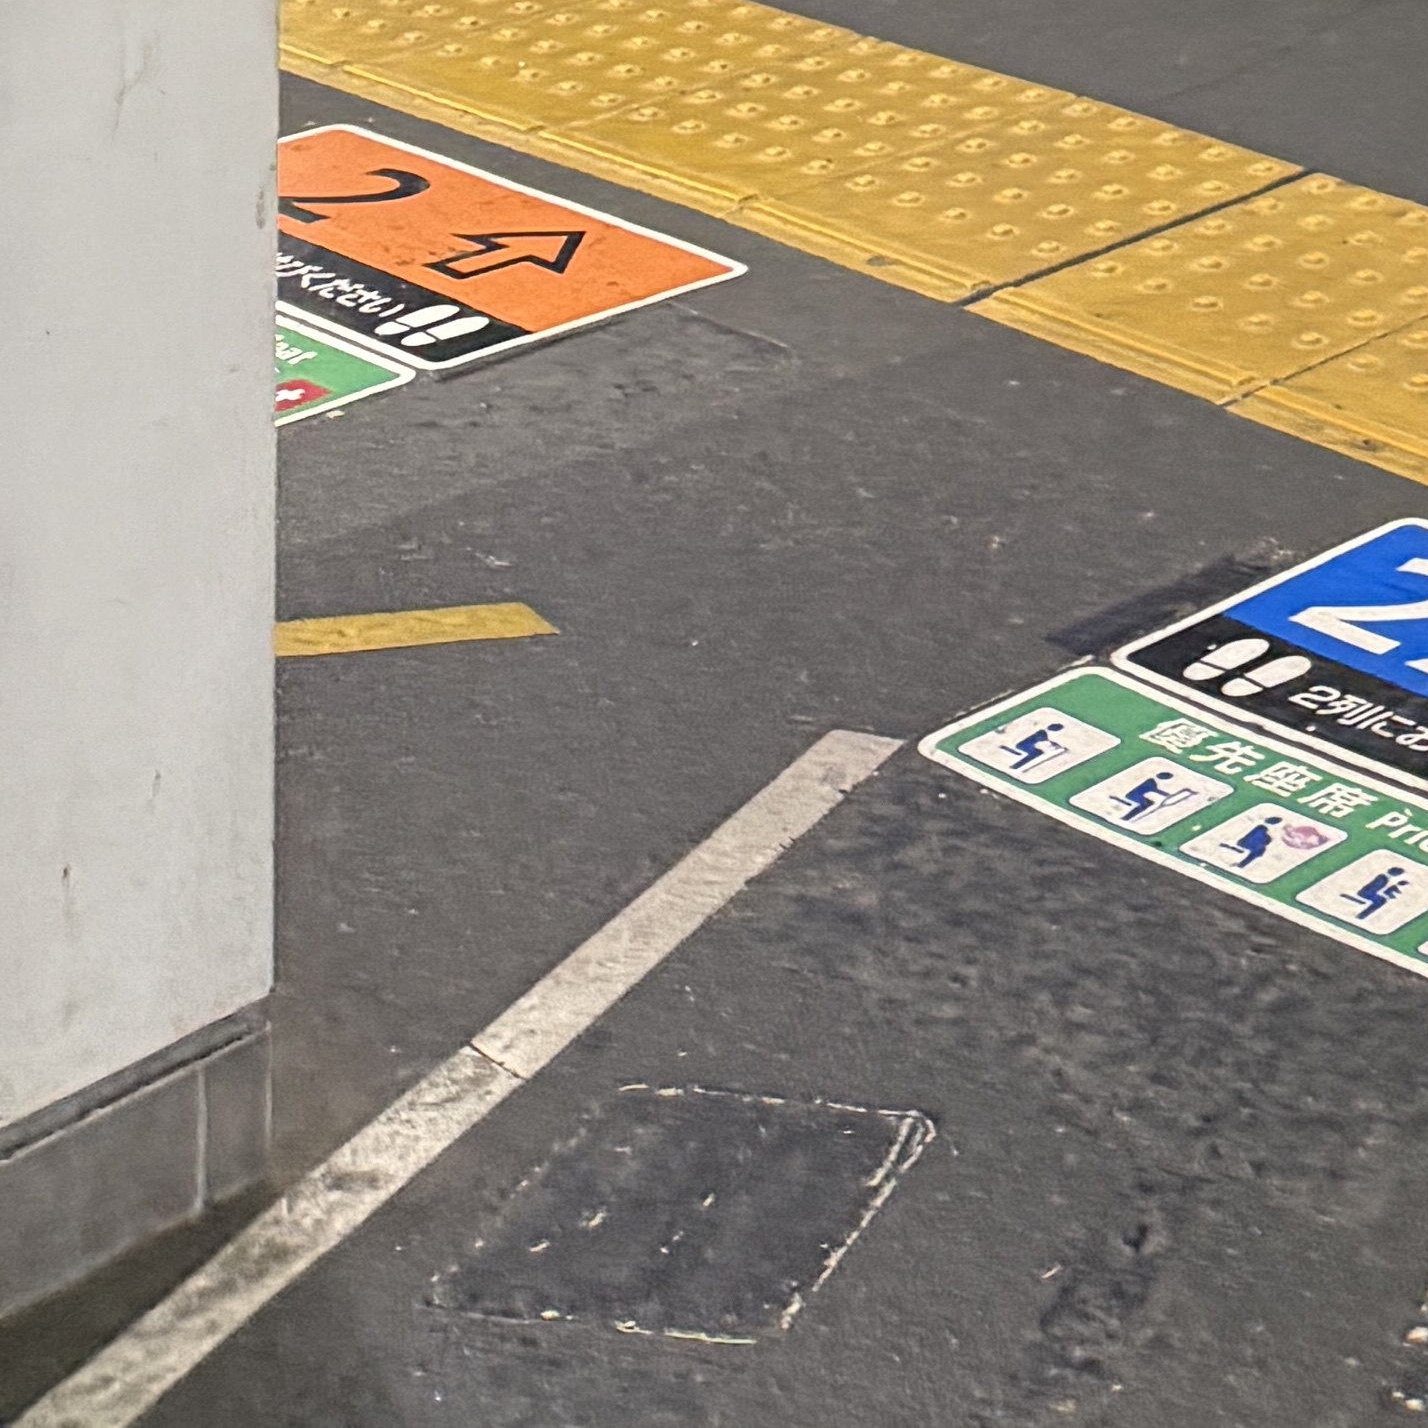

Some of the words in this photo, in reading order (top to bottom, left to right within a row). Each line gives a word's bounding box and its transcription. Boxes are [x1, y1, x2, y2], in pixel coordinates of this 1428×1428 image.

[277, 168, 431, 224] 2
[276, 252, 405, 318] びください
[1138, 717, 1378, 820] 優先座席
